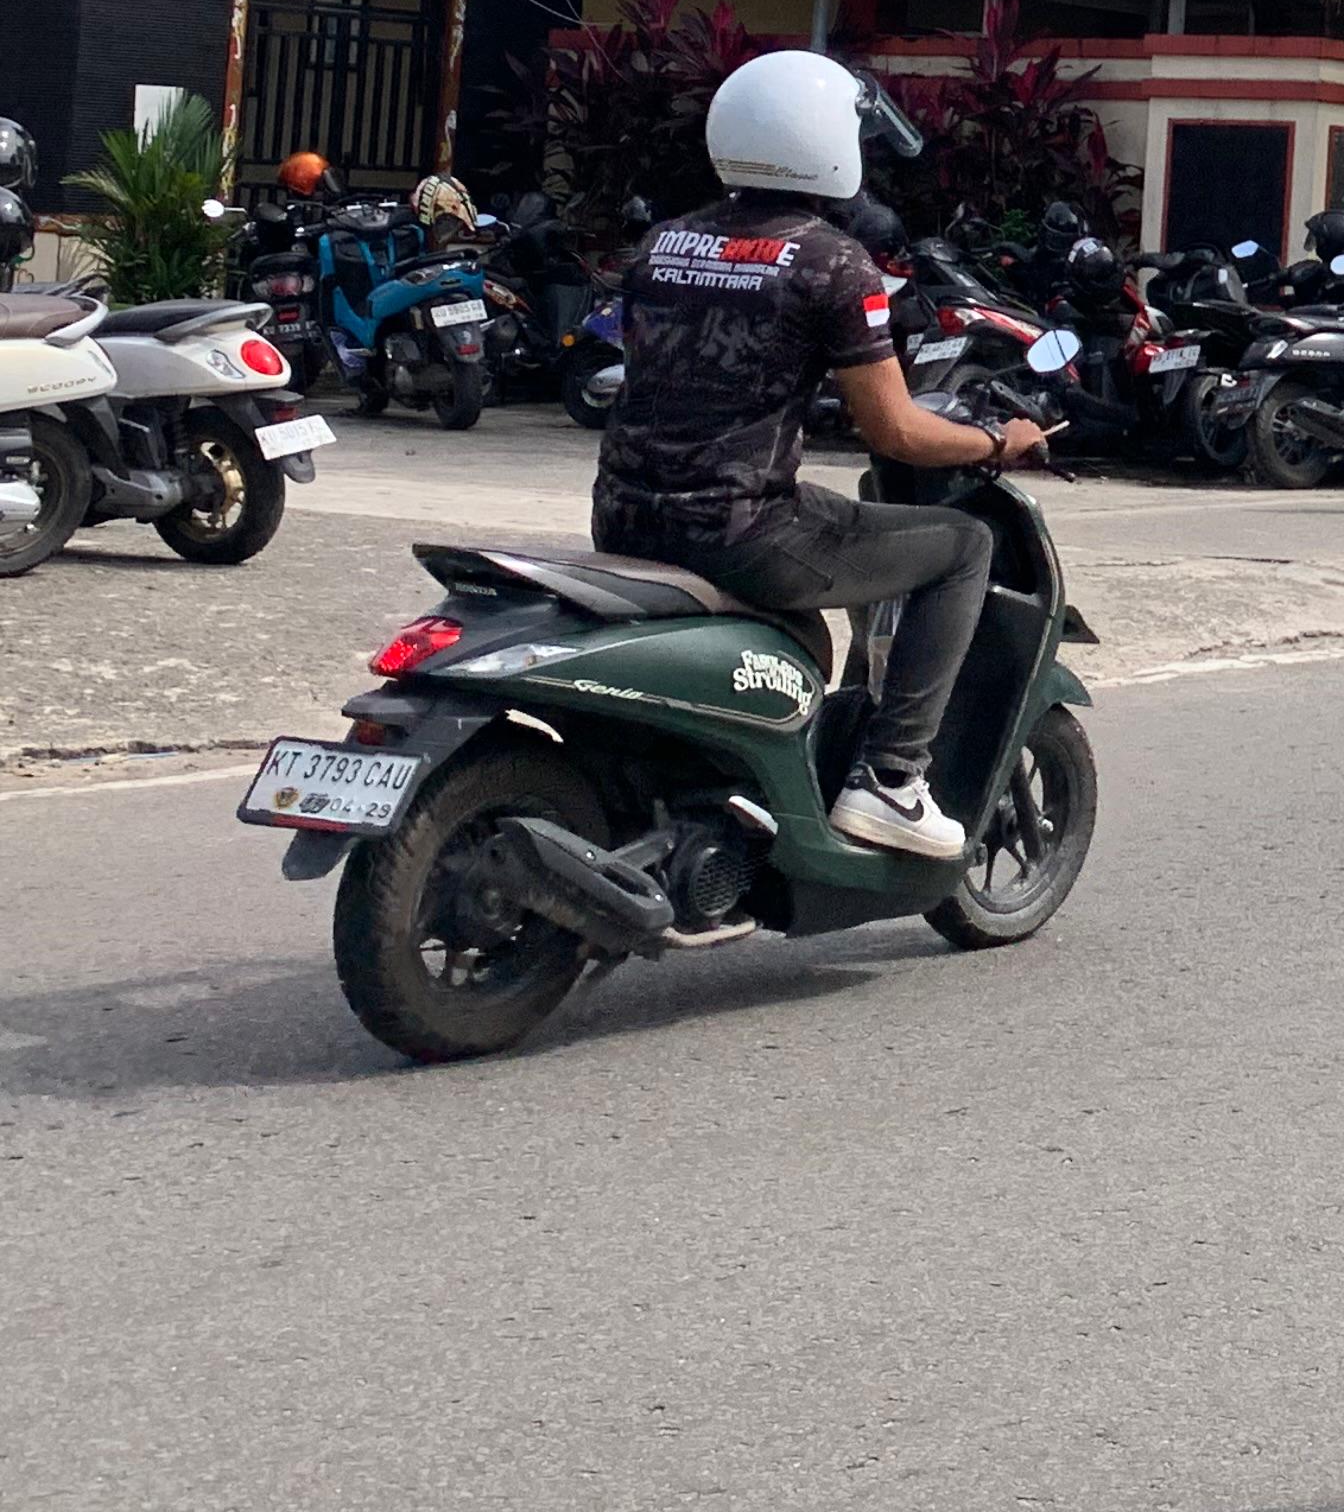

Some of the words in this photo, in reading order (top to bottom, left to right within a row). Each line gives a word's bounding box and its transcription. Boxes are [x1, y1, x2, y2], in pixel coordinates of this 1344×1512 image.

[574, 679, 644, 701] Genio
[267, 751, 302, 777] KT
[304, 755, 362, 784] 3793
[363, 761, 414, 790] CAU
